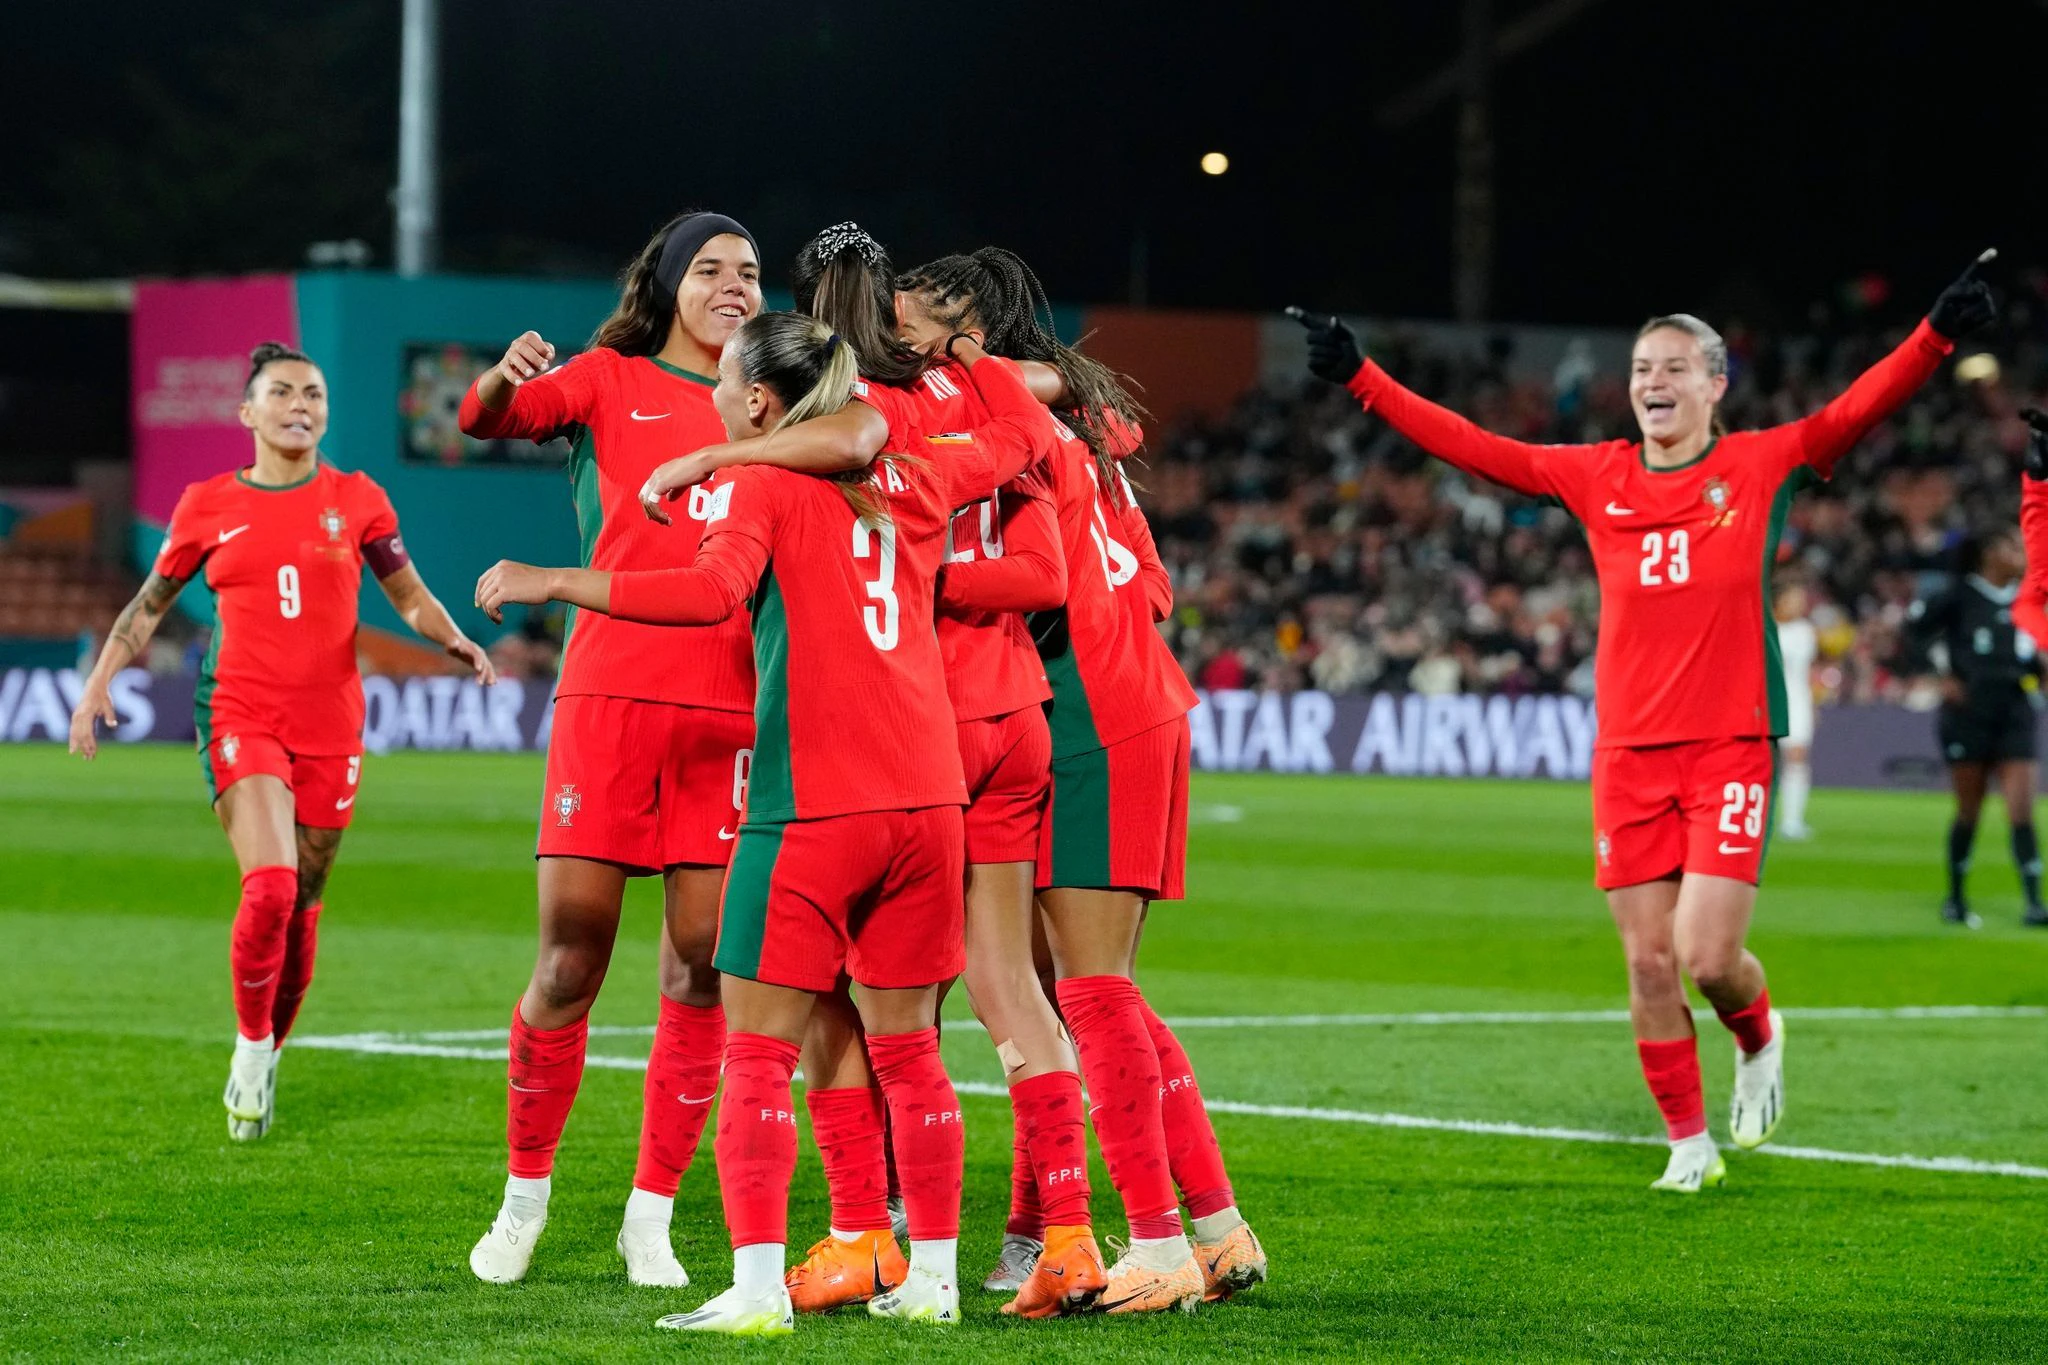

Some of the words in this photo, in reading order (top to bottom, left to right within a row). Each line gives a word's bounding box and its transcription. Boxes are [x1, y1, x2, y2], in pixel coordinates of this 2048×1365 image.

[688, 474, 715, 521] 6
[852, 513, 899, 651] 3
[1640, 529, 1690, 586] 23
[277, 564, 302, 619] 9
[363, 674, 524, 757] QATAR
[1190, 689, 1335, 774] ATAR
[1351, 692, 1596, 779] AIRWAY
[1718, 781, 1765, 838] 23
